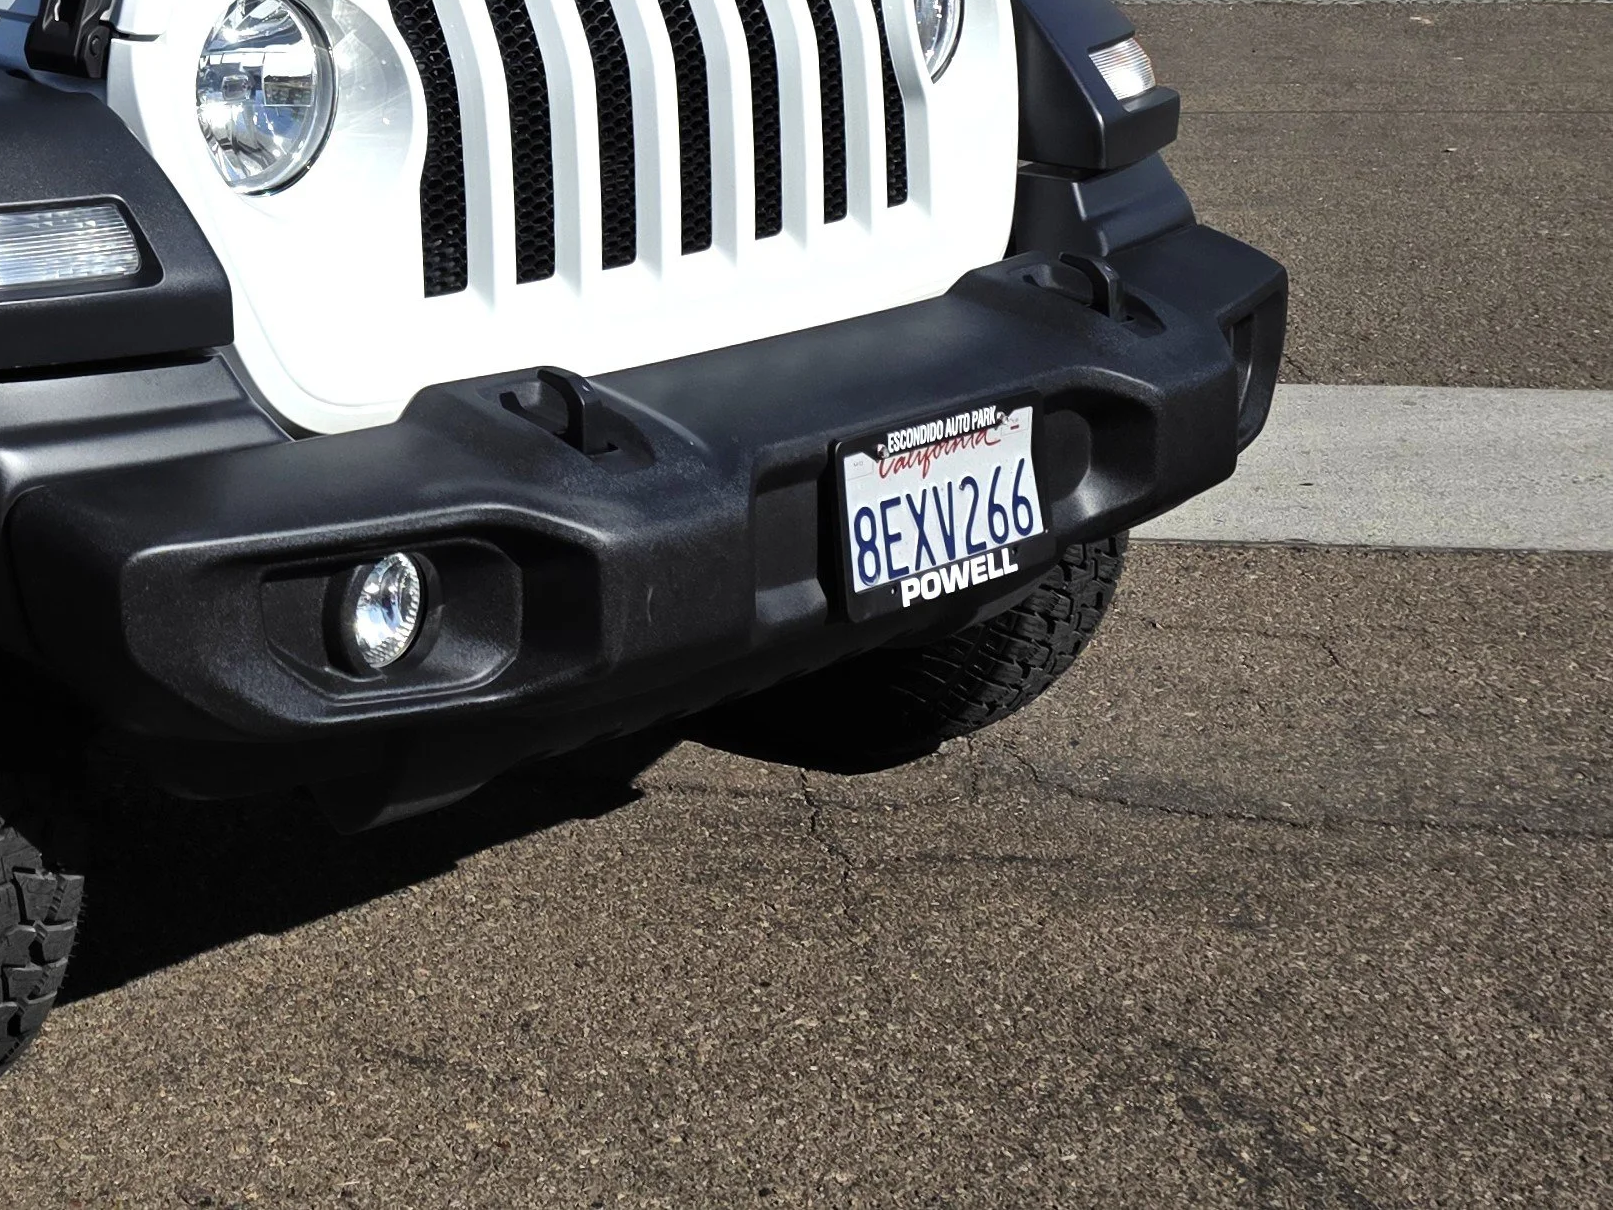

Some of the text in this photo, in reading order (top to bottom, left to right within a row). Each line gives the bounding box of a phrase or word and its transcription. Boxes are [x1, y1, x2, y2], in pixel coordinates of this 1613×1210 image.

[879, 428, 1001, 479] California
[887, 405, 997, 454] ESCONDIDO AUTO PARK
[853, 458, 1034, 587] 8EXV266
[900, 547, 1019, 608] POWELL
